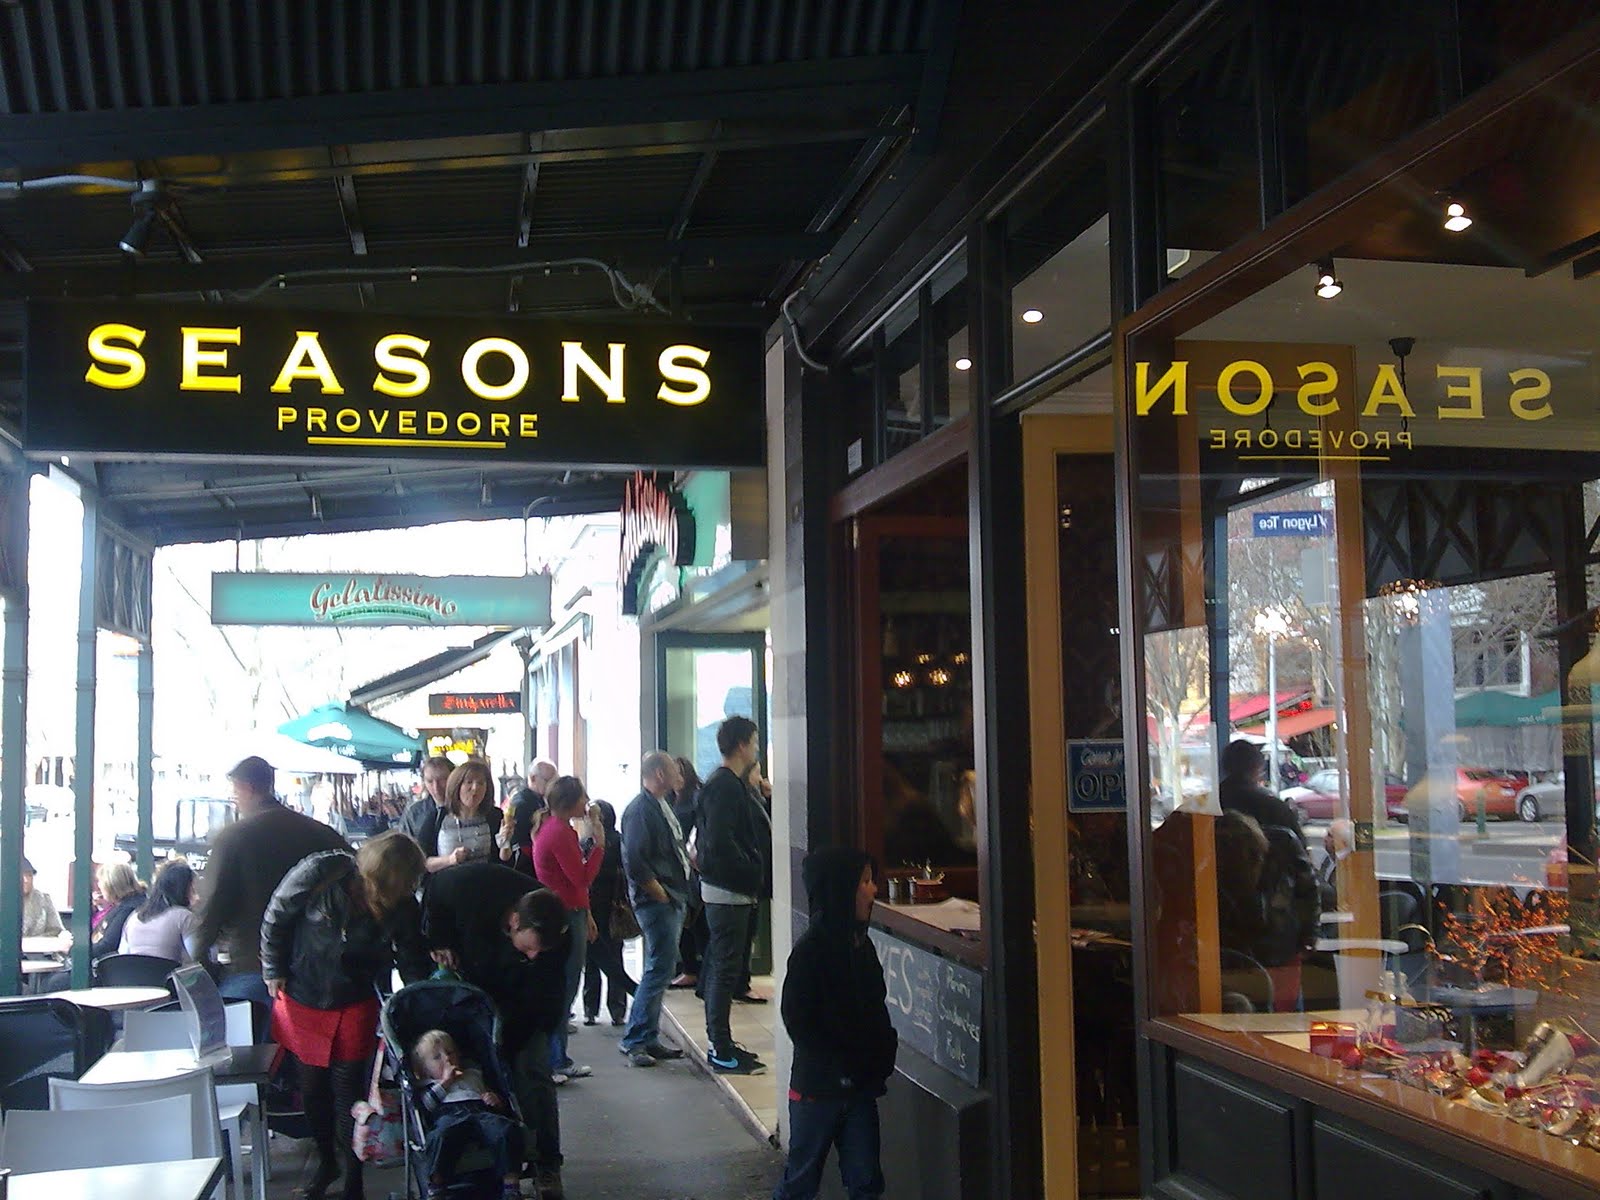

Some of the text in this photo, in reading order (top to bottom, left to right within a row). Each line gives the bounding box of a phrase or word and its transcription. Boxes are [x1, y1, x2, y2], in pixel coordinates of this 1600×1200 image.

[84, 322, 713, 407] SEASONS
[276, 405, 540, 438] PROVEDORE
[310, 575, 458, 621] Gelatissimo
[1075, 771, 1126, 801] OP
